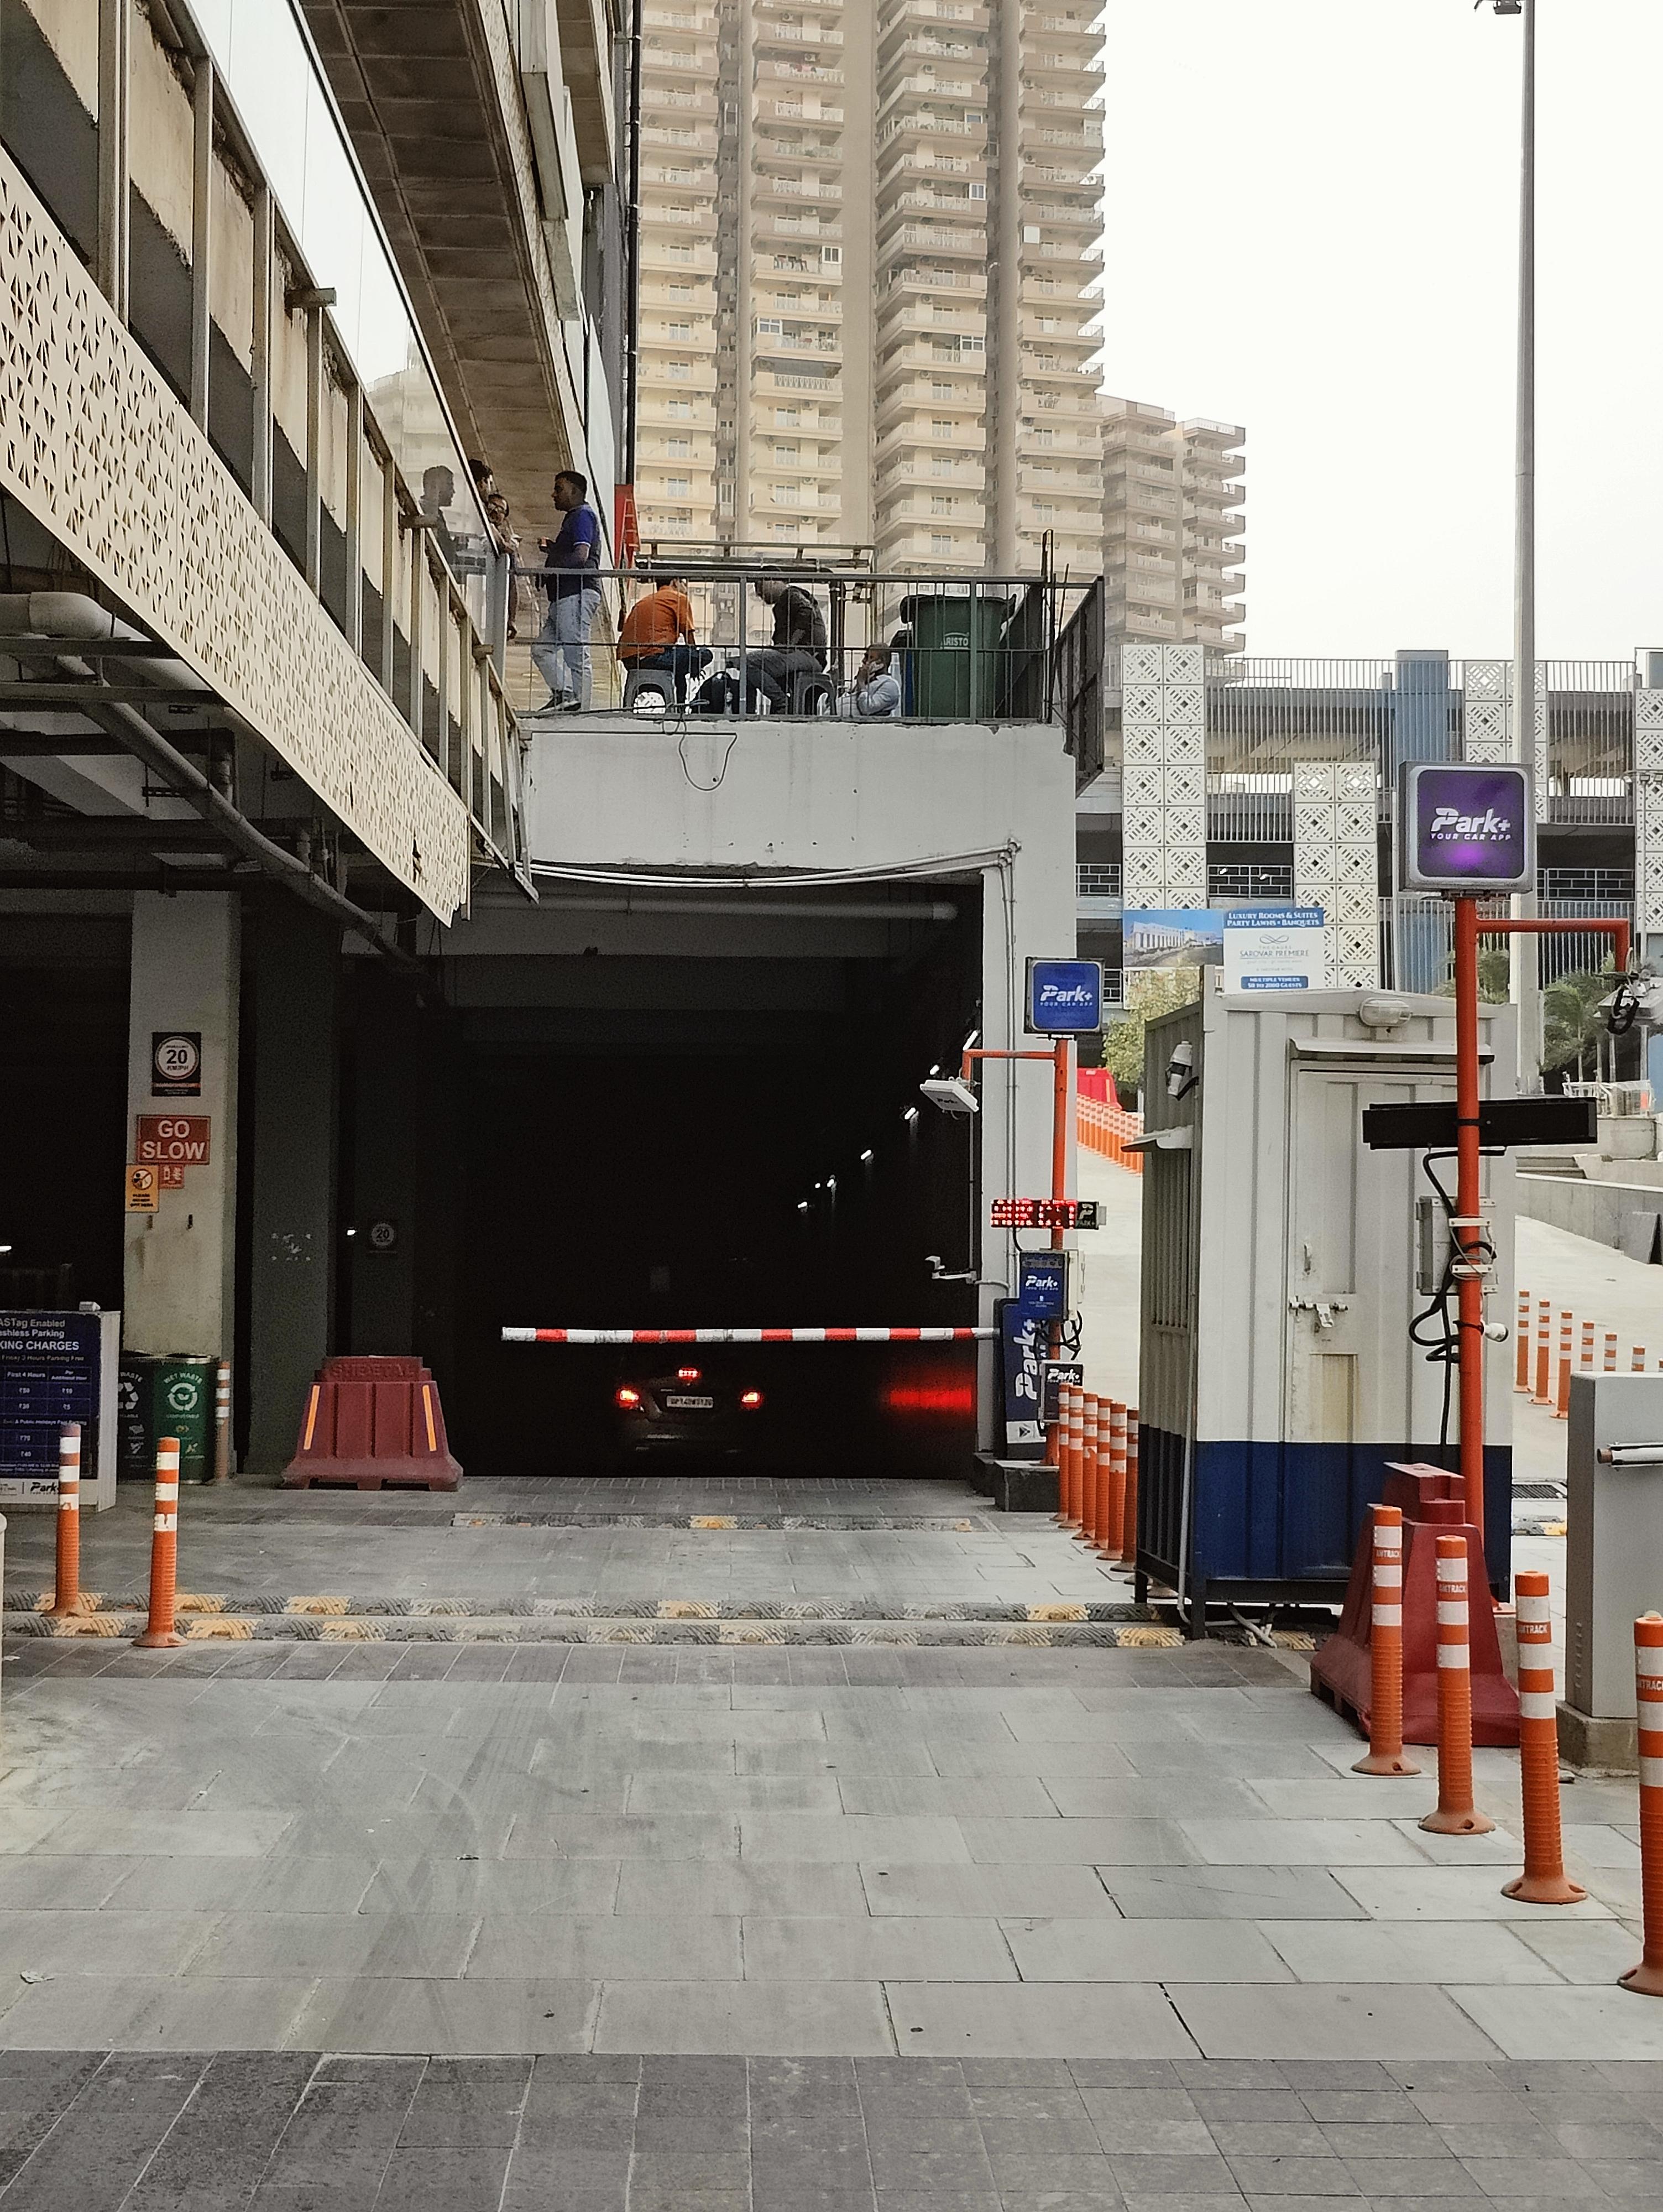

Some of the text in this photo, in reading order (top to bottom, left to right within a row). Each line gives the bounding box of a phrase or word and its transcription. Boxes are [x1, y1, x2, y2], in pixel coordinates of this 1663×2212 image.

[940, 637, 968, 646] ARISTO
[1431, 807, 1511, 833] Park+
[1040, 985, 1092, 1002] Park+
[166, 1049, 187, 1064] 20
[158, 1120, 190, 1138] GO
[142, 1141, 206, 1160] SLOW
[376, 1228, 390, 1239] 20
[30, 1319, 65, 1327] Enabled
[32, 1329, 65, 1339] Parking
[26, 1341, 80, 1350] CHARGES
[1013, 1319, 1037, 1400] Park+
